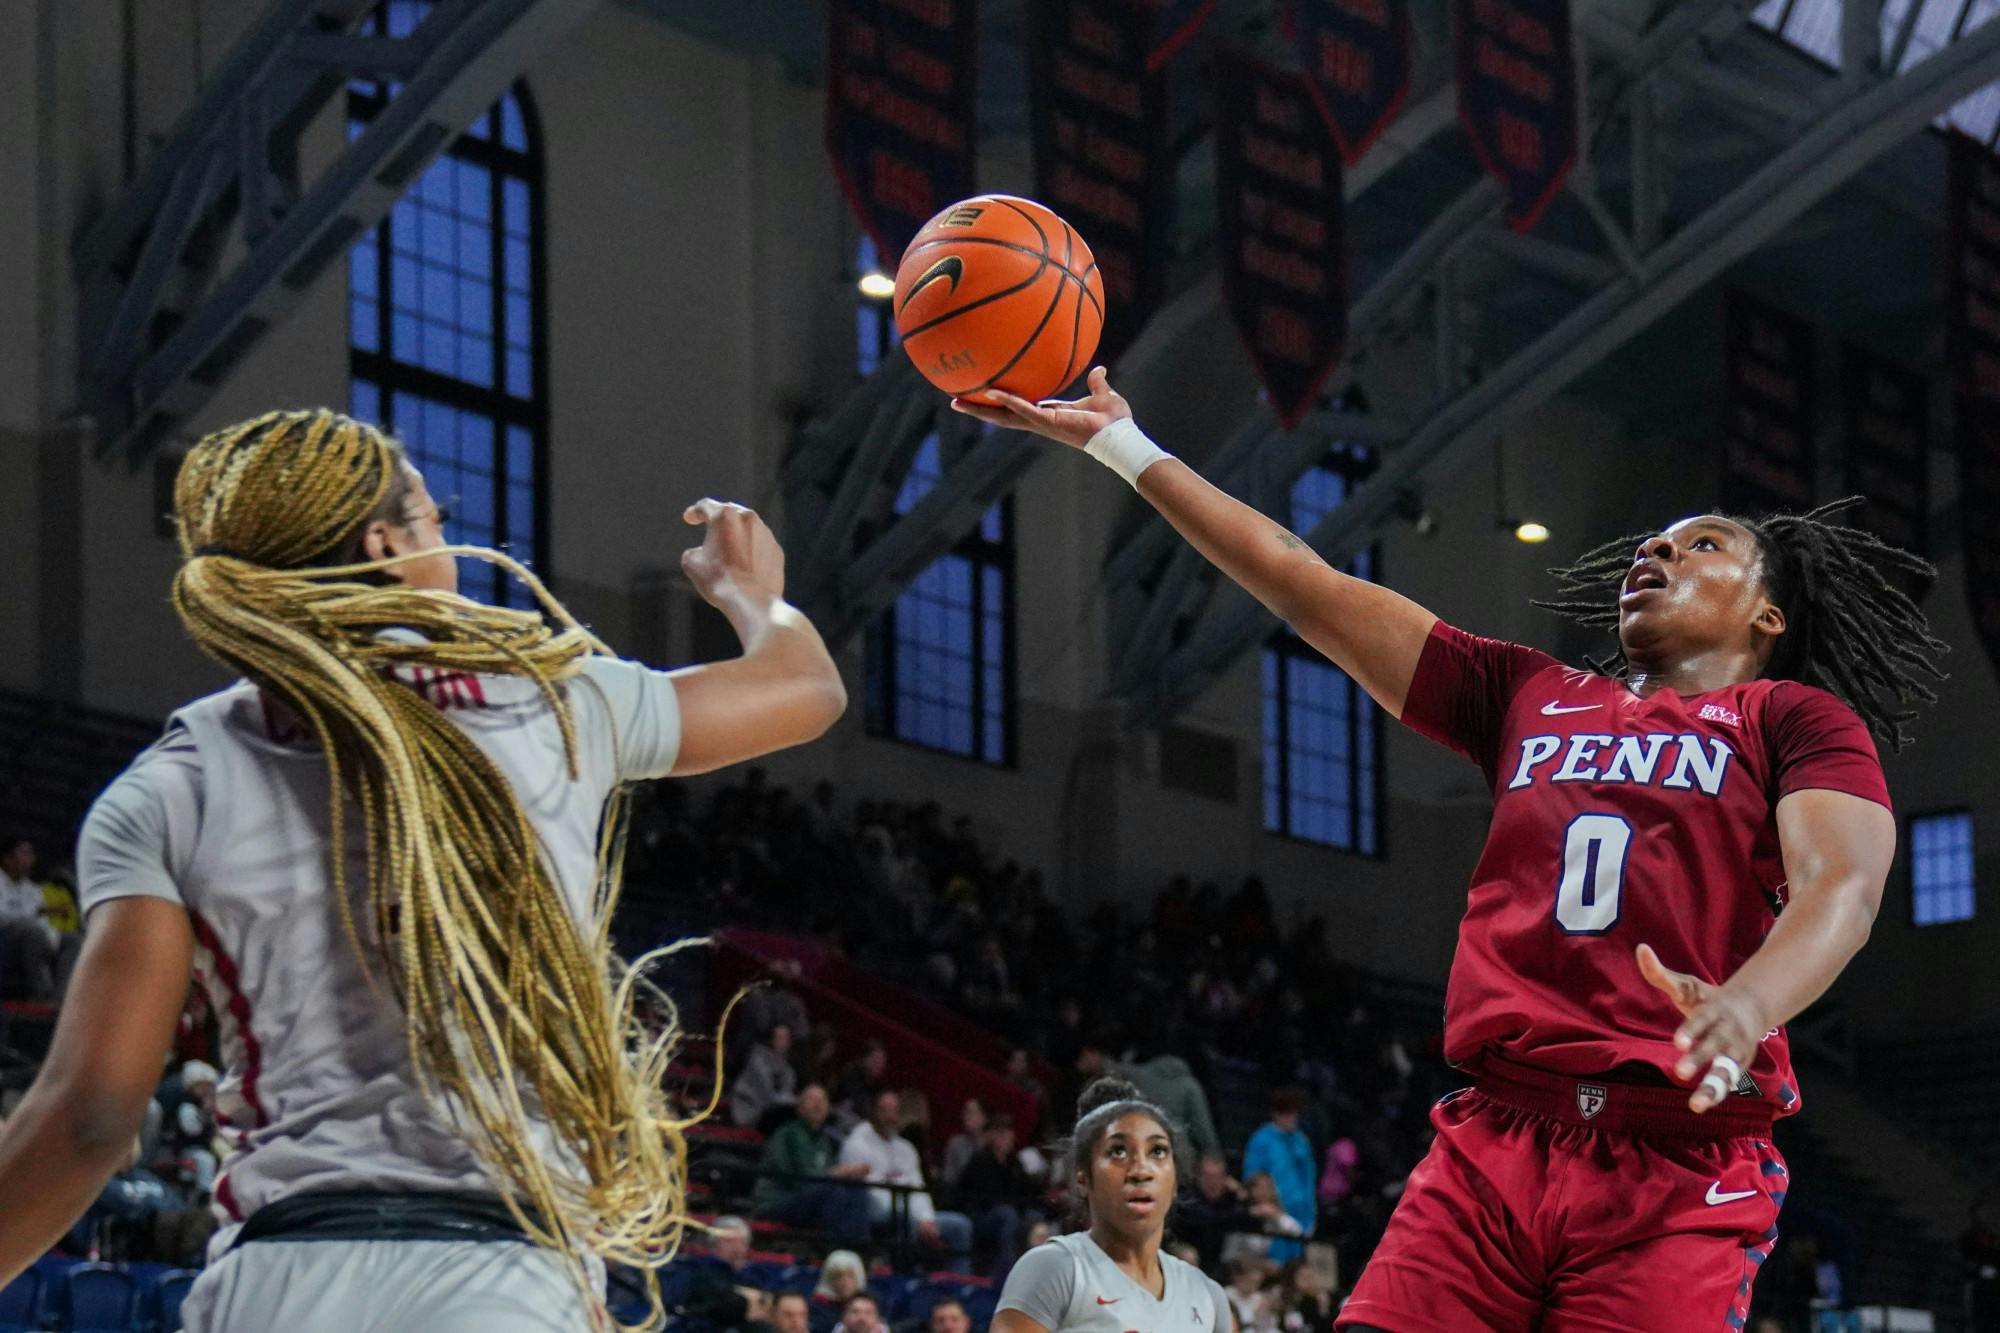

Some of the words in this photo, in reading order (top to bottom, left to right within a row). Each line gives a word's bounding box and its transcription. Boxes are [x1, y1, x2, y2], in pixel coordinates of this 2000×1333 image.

[1508, 731, 1736, 798] PENN
[1553, 812, 1634, 937] 0
[1580, 1087, 1604, 1096] PENN
[1585, 1097, 1598, 1113] P
